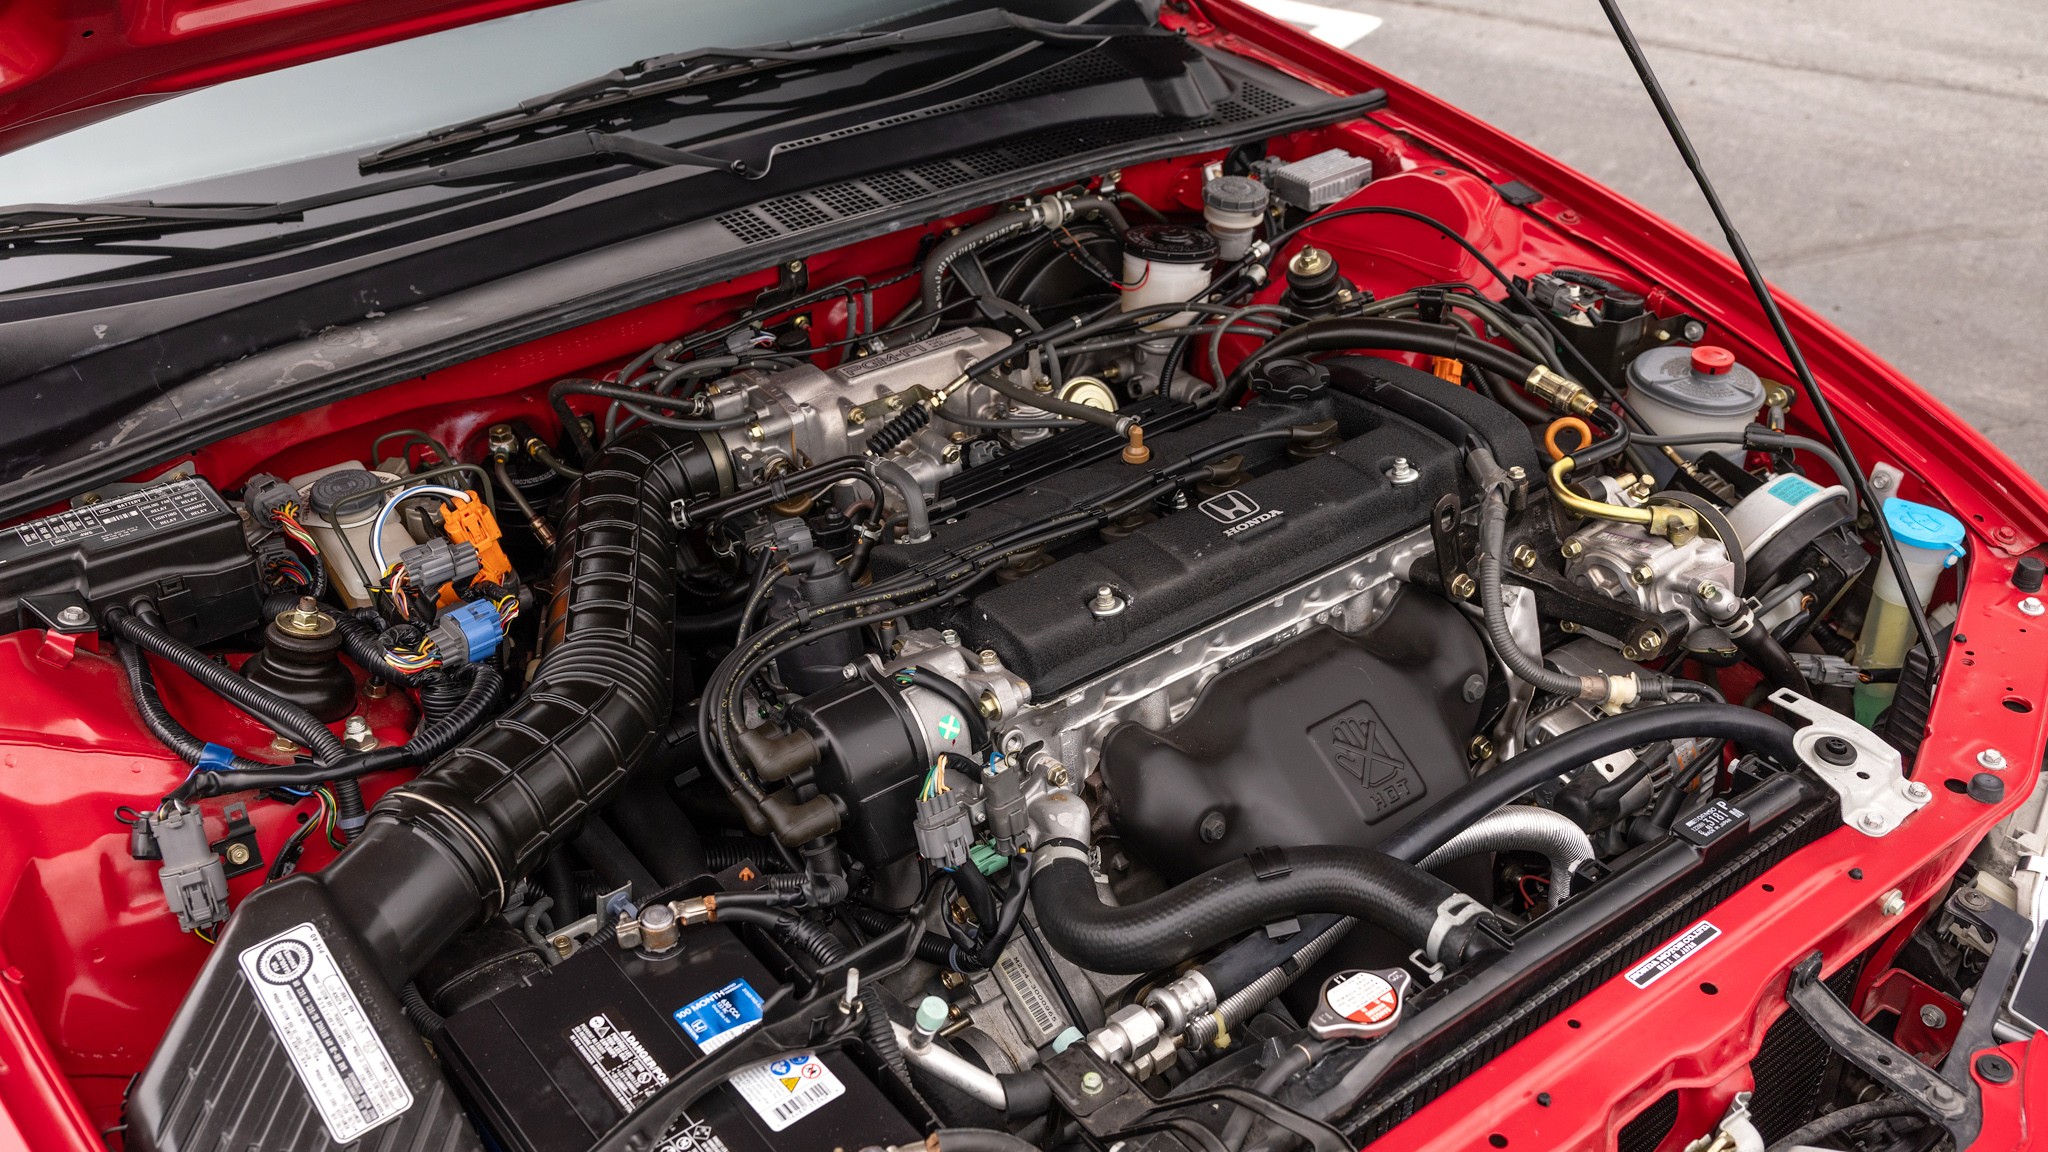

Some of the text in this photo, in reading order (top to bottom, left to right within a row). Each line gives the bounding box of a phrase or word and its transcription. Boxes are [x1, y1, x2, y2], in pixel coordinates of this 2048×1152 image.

[843, 344, 928, 376] PGM-FI
[117, 499, 141, 509] BATTERY
[180, 496, 198, 505] RELAY
[184, 502, 207, 513] DIMMER
[150, 505, 168, 514] RELAY
[152, 511, 178, 522] LIGHTING
[190, 508, 208, 516] RELAY
[160, 517, 177, 525] RELAY
[1222, 509, 1284, 537] HONDA
[1370, 778, 1411, 812] HOT
[1702, 800, 1729, 827] 3181 P
[1629, 960, 1658, 981] HONDA
[1657, 941, 1686, 962] MOTOR
[676, 1008, 692, 1019] 100
[691, 990, 725, 1012] MONTH
[729, 1008, 741, 1019] CCA
[315, 1020, 330, 1039] SERVICE
[682, 1021, 700, 1040] HONDA
